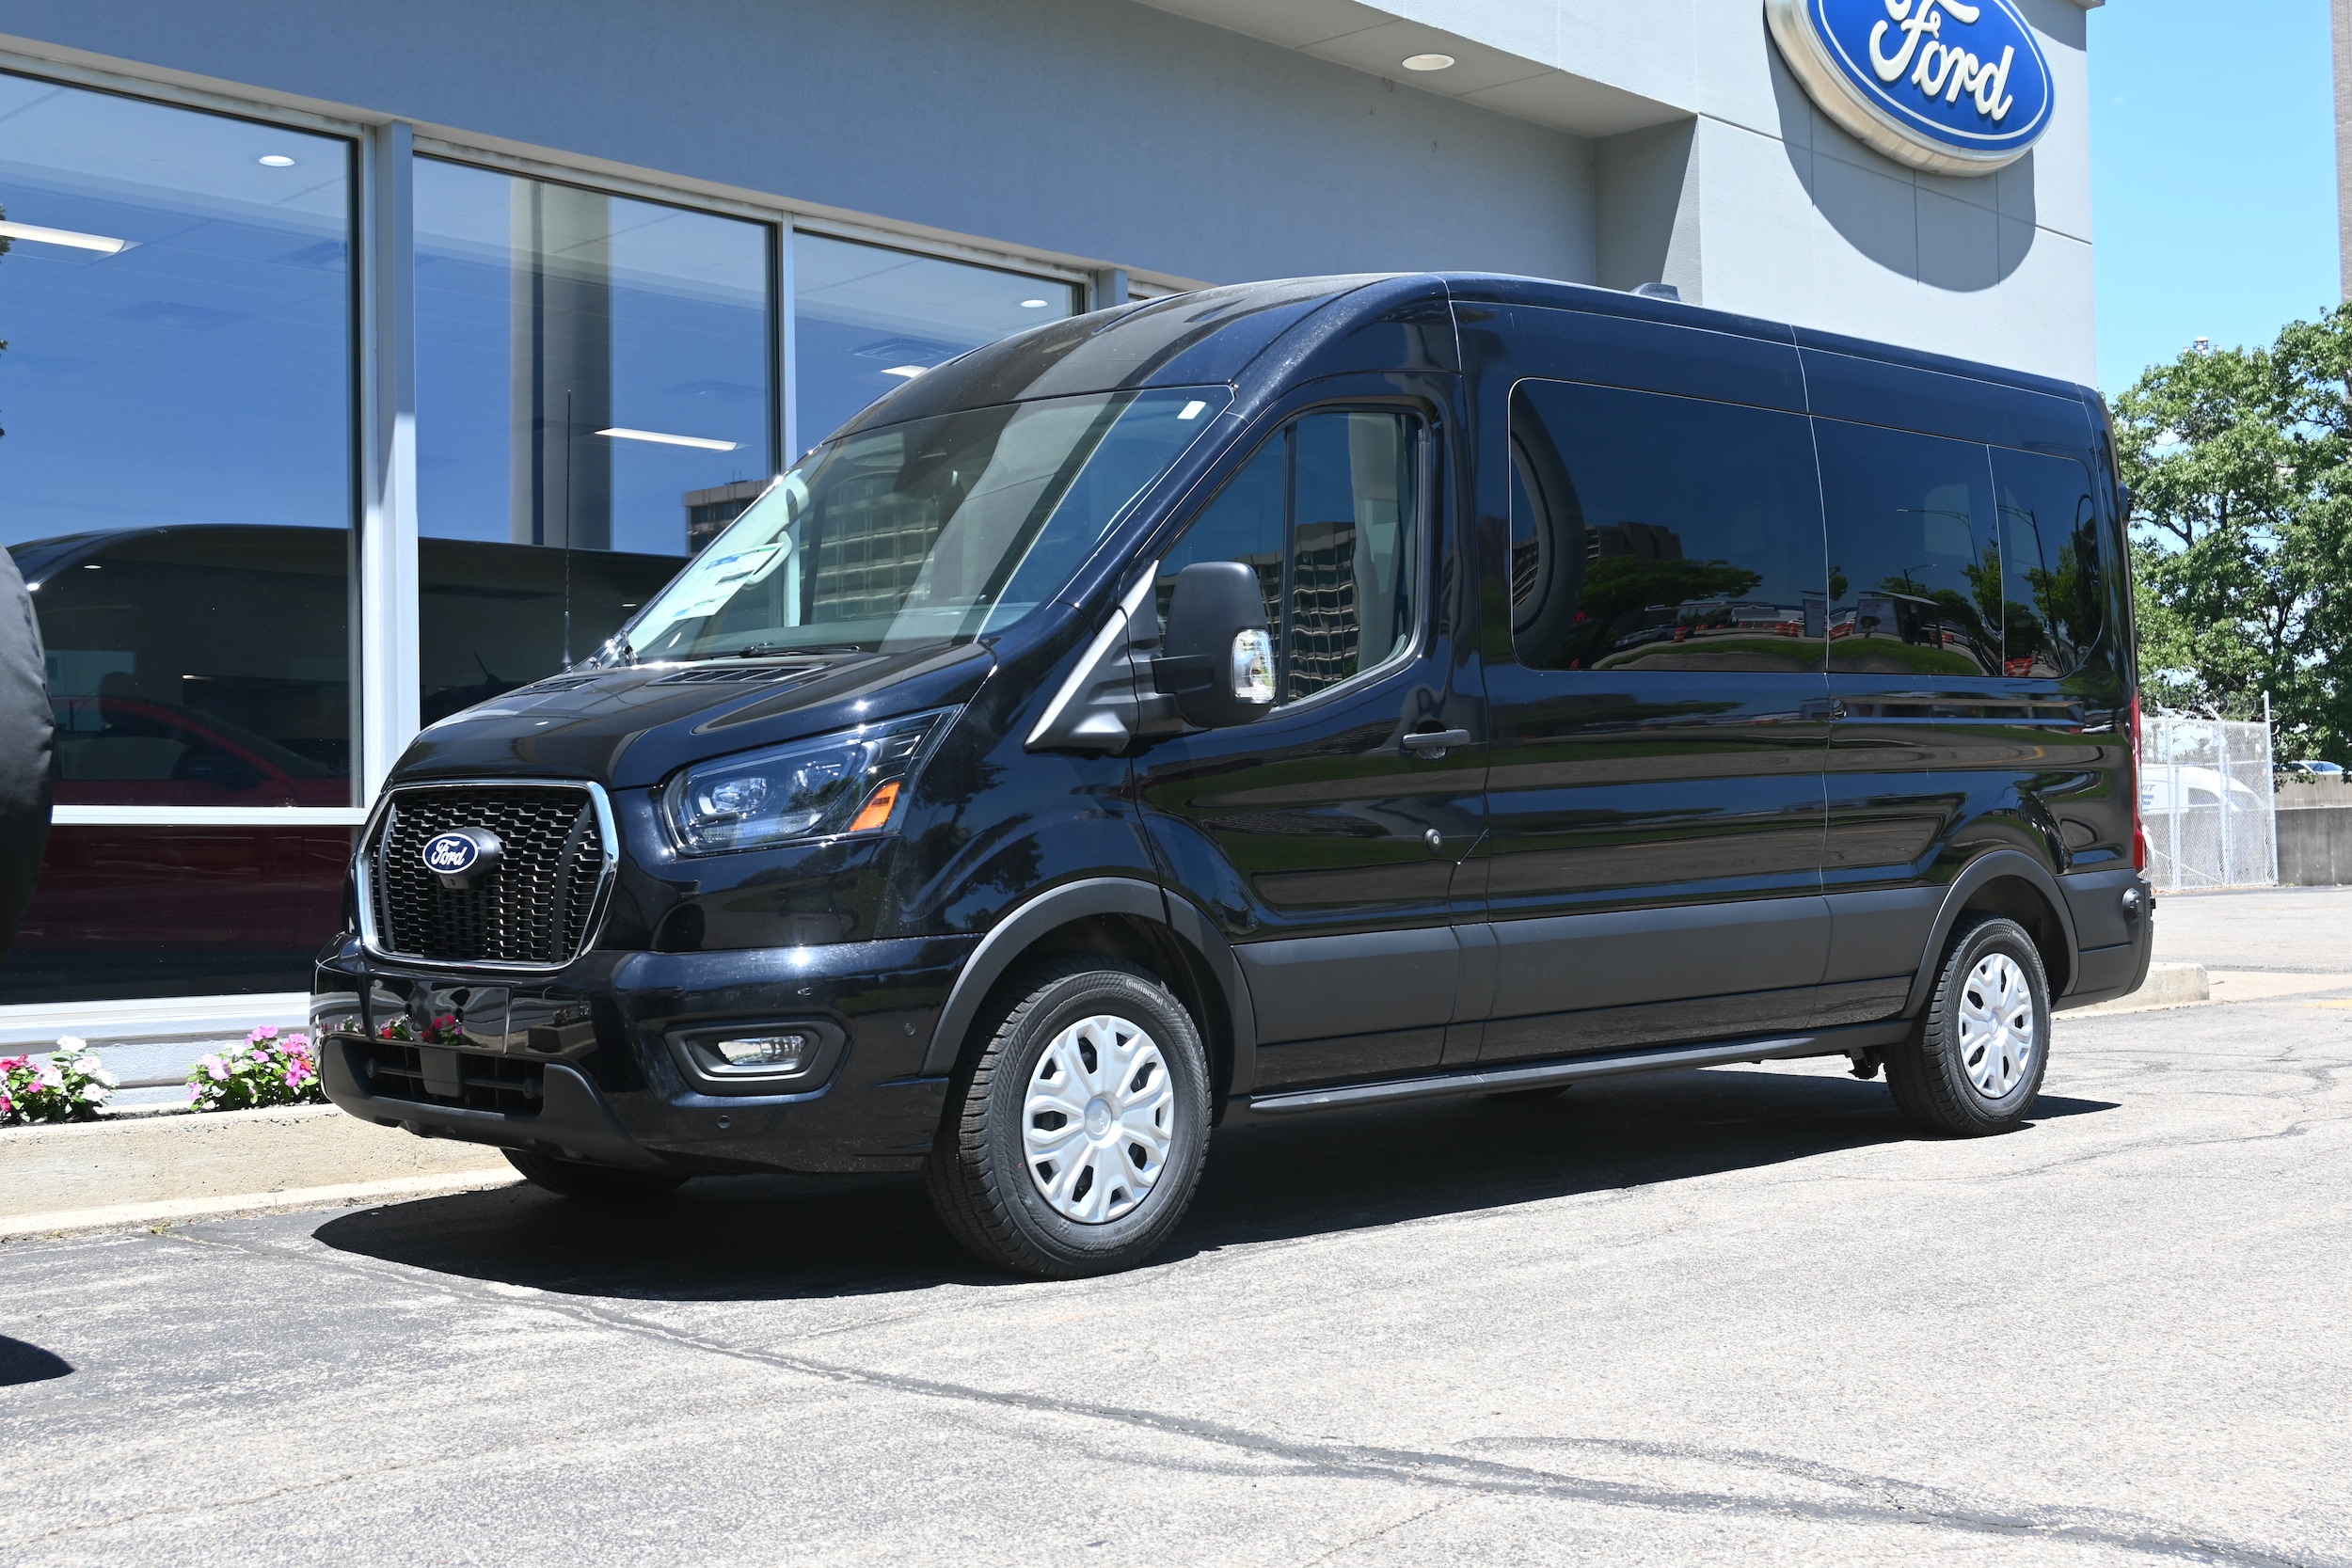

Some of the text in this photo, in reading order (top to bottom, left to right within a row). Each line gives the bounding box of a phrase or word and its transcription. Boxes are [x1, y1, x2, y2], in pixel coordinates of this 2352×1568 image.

[1869, 0, 2015, 120] Ford
[431, 839, 468, 865] Ford
[1125, 978, 1164, 1006] Continental
